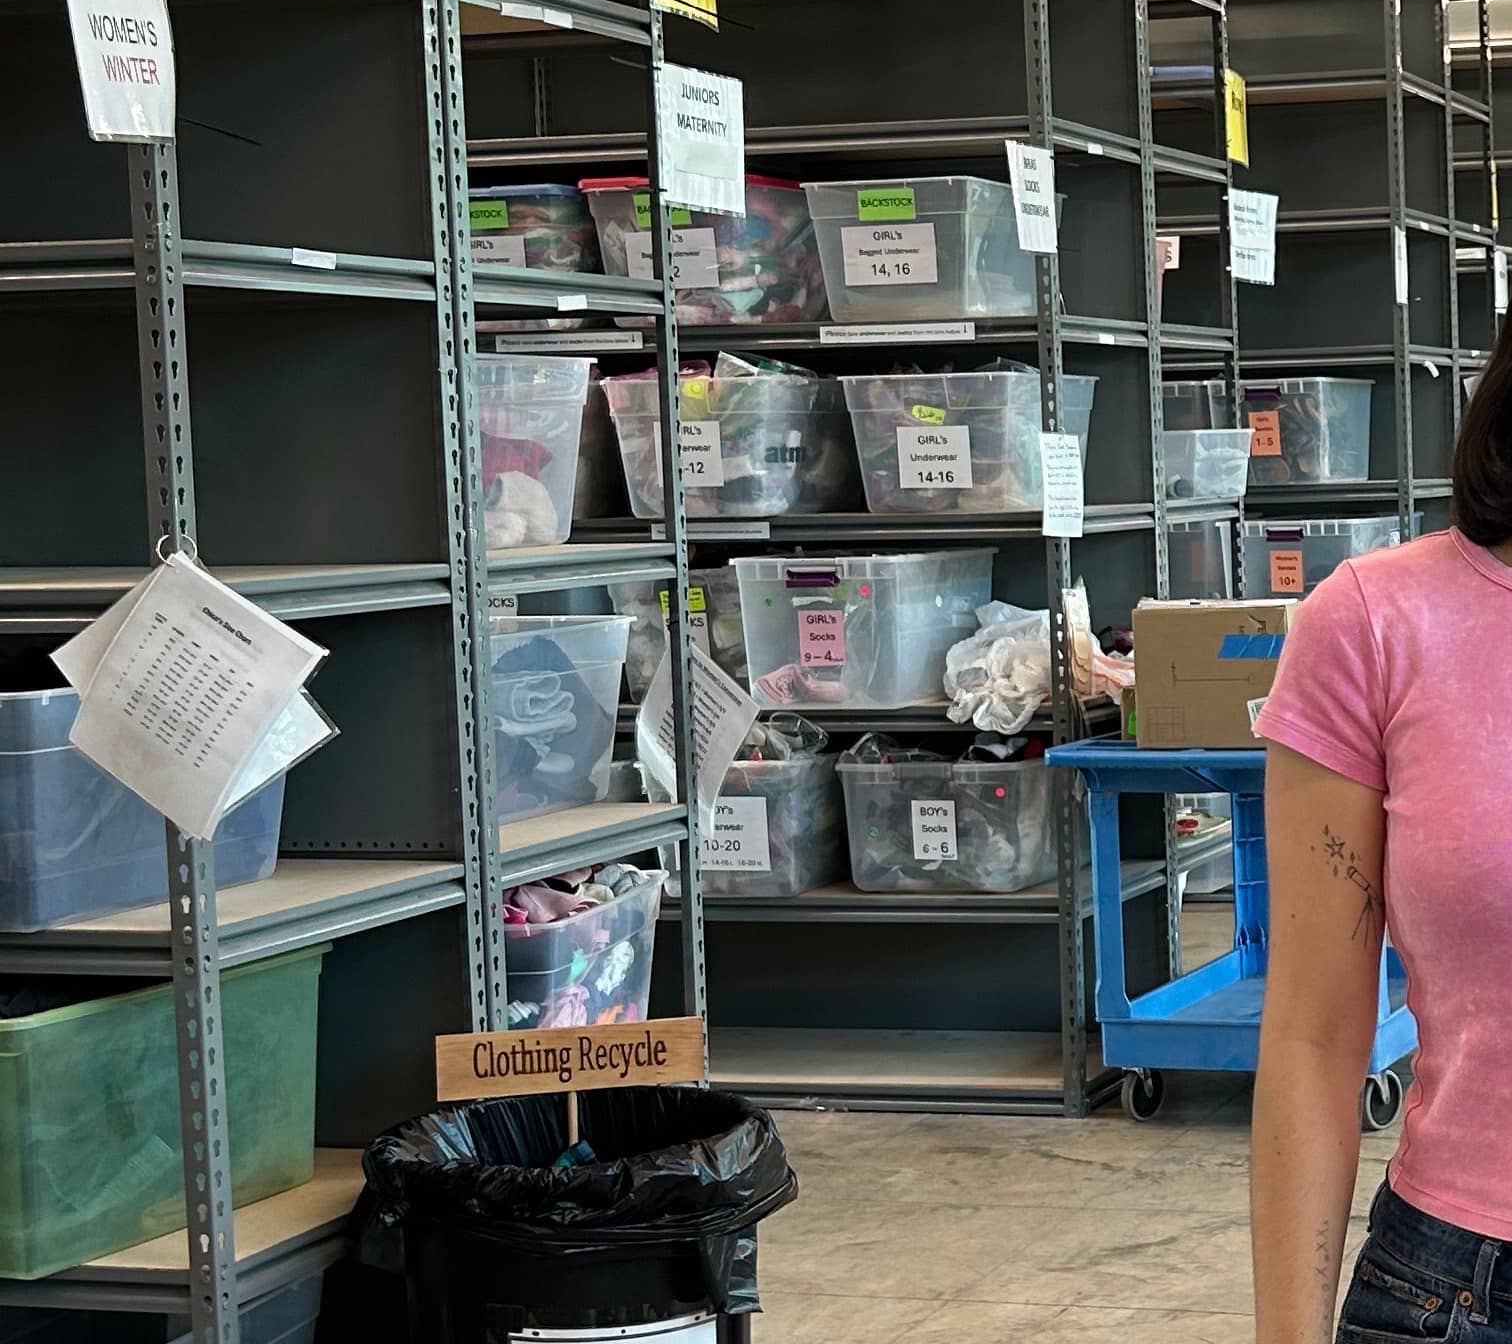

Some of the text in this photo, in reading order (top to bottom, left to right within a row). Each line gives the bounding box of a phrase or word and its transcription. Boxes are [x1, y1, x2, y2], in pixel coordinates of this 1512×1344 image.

[88, 13, 158, 47] WOMEN'S
[102, 55, 160, 85] WINTER
[681, 83, 720, 106] JUNIORS
[677, 112, 727, 137] MATERNITY
[860, 197, 913, 207] BACKSTOCK
[470, 209, 503, 218] KSTOCK
[872, 231, 902, 241] GIRL's
[871, 262, 911, 277] 14, 16
[682, 425, 702, 436] RL's
[917, 435, 948, 445] GIRL's
[682, 444, 712, 452] erwear
[910, 453, 958, 462] Underwear
[685, 462, 705, 474] -12
[917, 470, 955, 483] 14-16
[809, 632, 836, 641] Socks
[804, 652, 812, 662] 9
[823, 649, 832, 662] 4
[920, 807, 948, 816] BOY's
[922, 825, 948, 833] Socks
[703, 839, 741, 851] 10-20
[473, 1030, 667, 1082] Clothing Recycle
